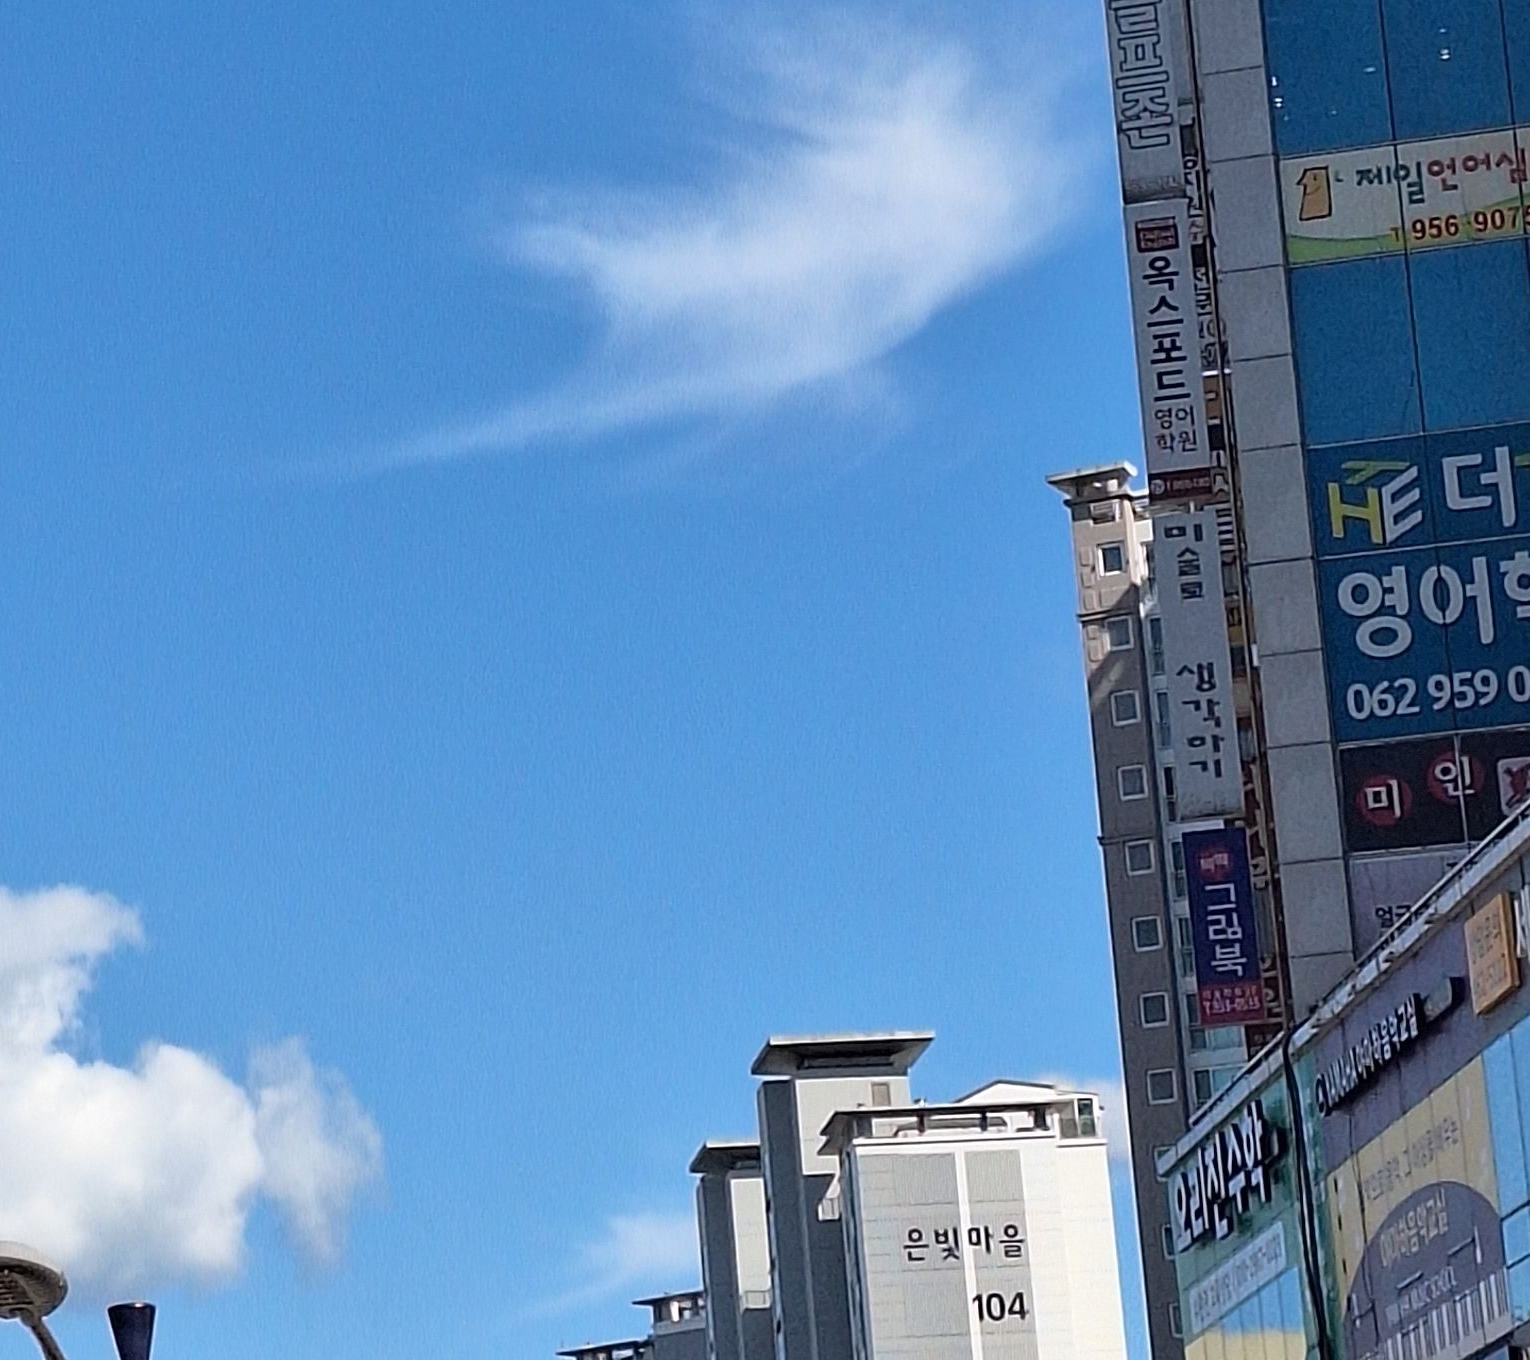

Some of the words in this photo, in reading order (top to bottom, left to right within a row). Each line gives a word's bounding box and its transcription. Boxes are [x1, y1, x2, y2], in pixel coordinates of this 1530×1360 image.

[1142, 255, 1192, 403] 옥스포드
[1175, 660, 1225, 779] 생각하기
[1346, 677, 1420, 721] 062
[1427, 668, 1499, 712] 959
[1204, 882, 1248, 978] 그림북
[903, 1223, 1026, 1262] 은빛마을
[971, 1292, 1029, 1322] 104
